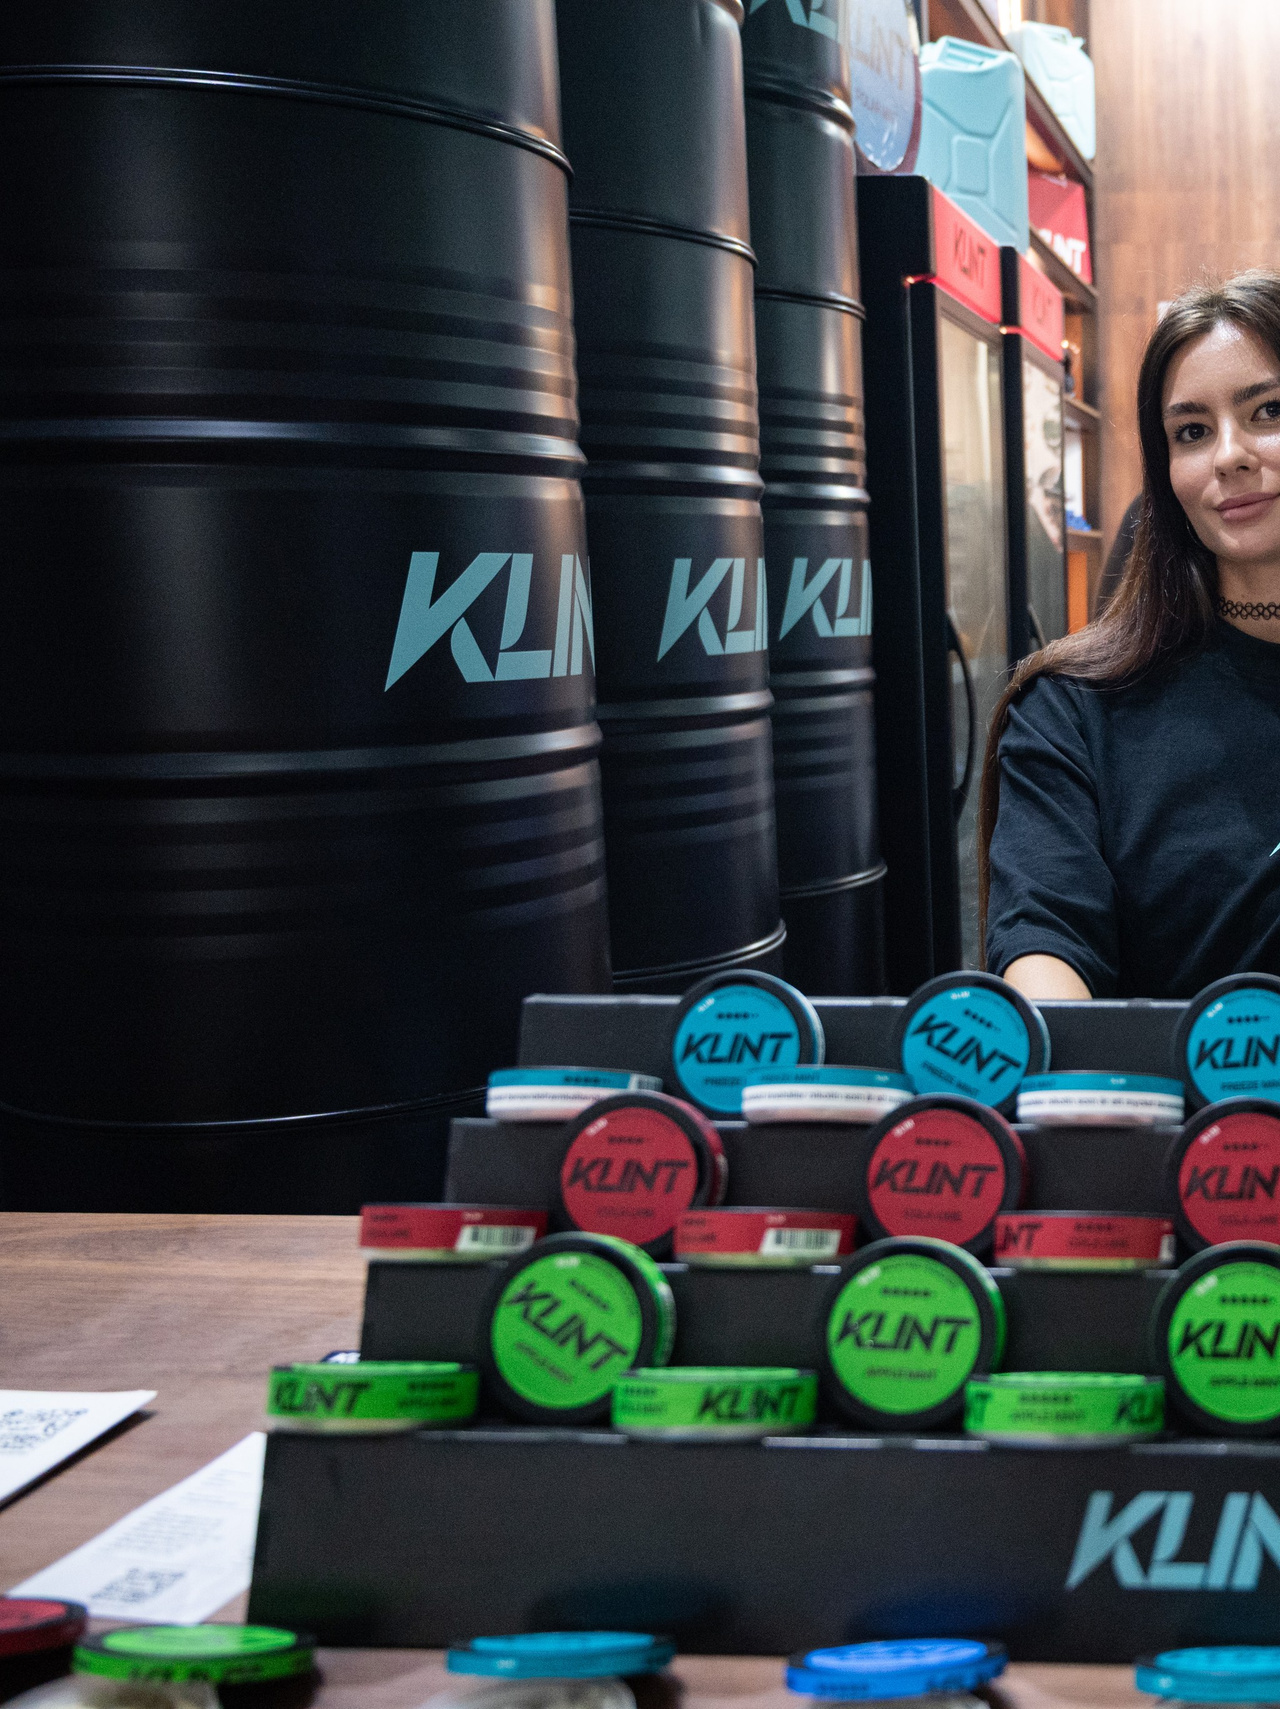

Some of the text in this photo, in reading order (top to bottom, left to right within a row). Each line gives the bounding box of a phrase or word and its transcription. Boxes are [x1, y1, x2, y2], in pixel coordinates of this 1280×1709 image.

[384, 551, 596, 693] KLIN
[657, 557, 768, 663] KLI
[778, 557, 872, 642] KLI
[682, 1032, 793, 1064] KLINT
[911, 1013, 1022, 1083] KLINT
[568, 1157, 689, 1194] KLINT
[870, 1158, 998, 1199] KLINT
[506, 1280, 629, 1372] KLINT
[835, 1310, 973, 1354] KLINT
